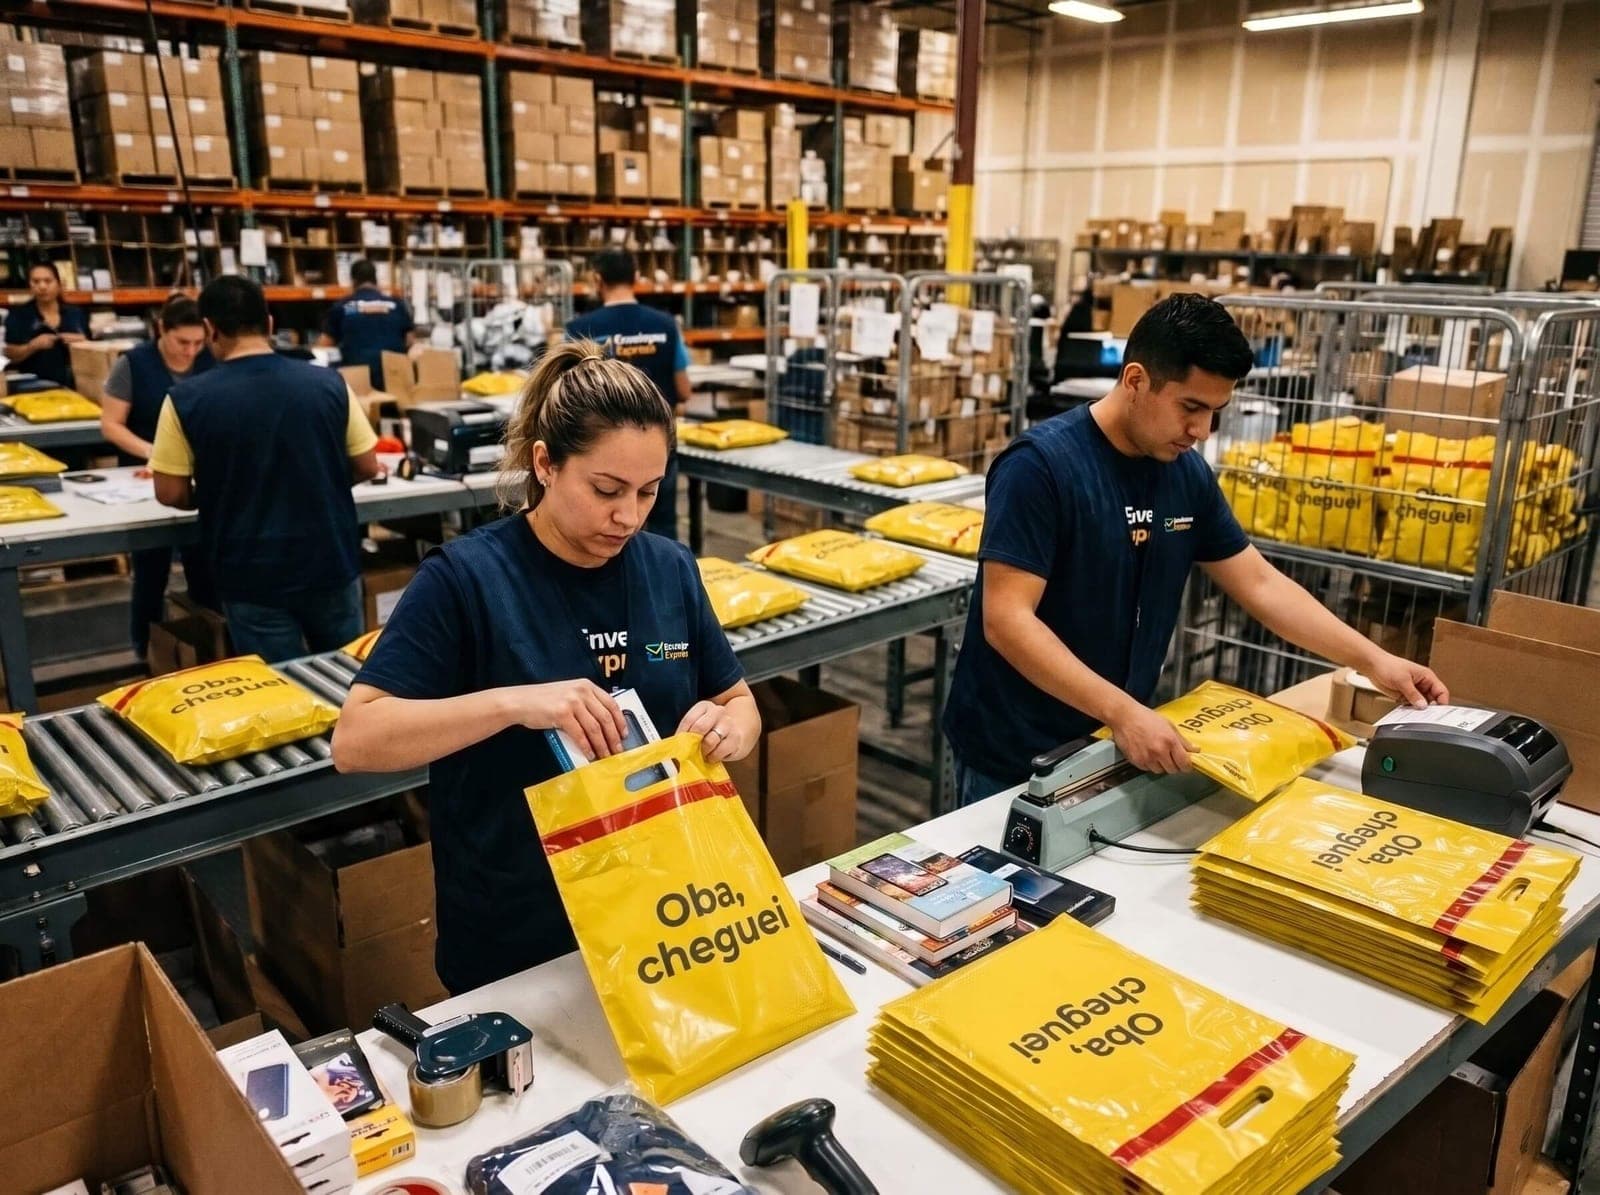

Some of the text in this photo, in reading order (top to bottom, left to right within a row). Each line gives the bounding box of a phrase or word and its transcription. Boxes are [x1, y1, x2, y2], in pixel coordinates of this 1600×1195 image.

[581, 630, 629, 651] nve
[170, 677, 289, 715] cheguei
[182, 676, 252, 695] Oba,
[1178, 698, 1253, 734] cheguei
[1221, 713, 1274, 731] Oba,
[1311, 810, 1398, 873] cheguei
[1357, 834, 1423, 865] Oba,
[656, 881, 745, 928] Oba,
[637, 895, 790, 985] cheguei
[1008, 977, 1147, 1065] cheguei
[1069, 1012, 1164, 1057] Oba,
